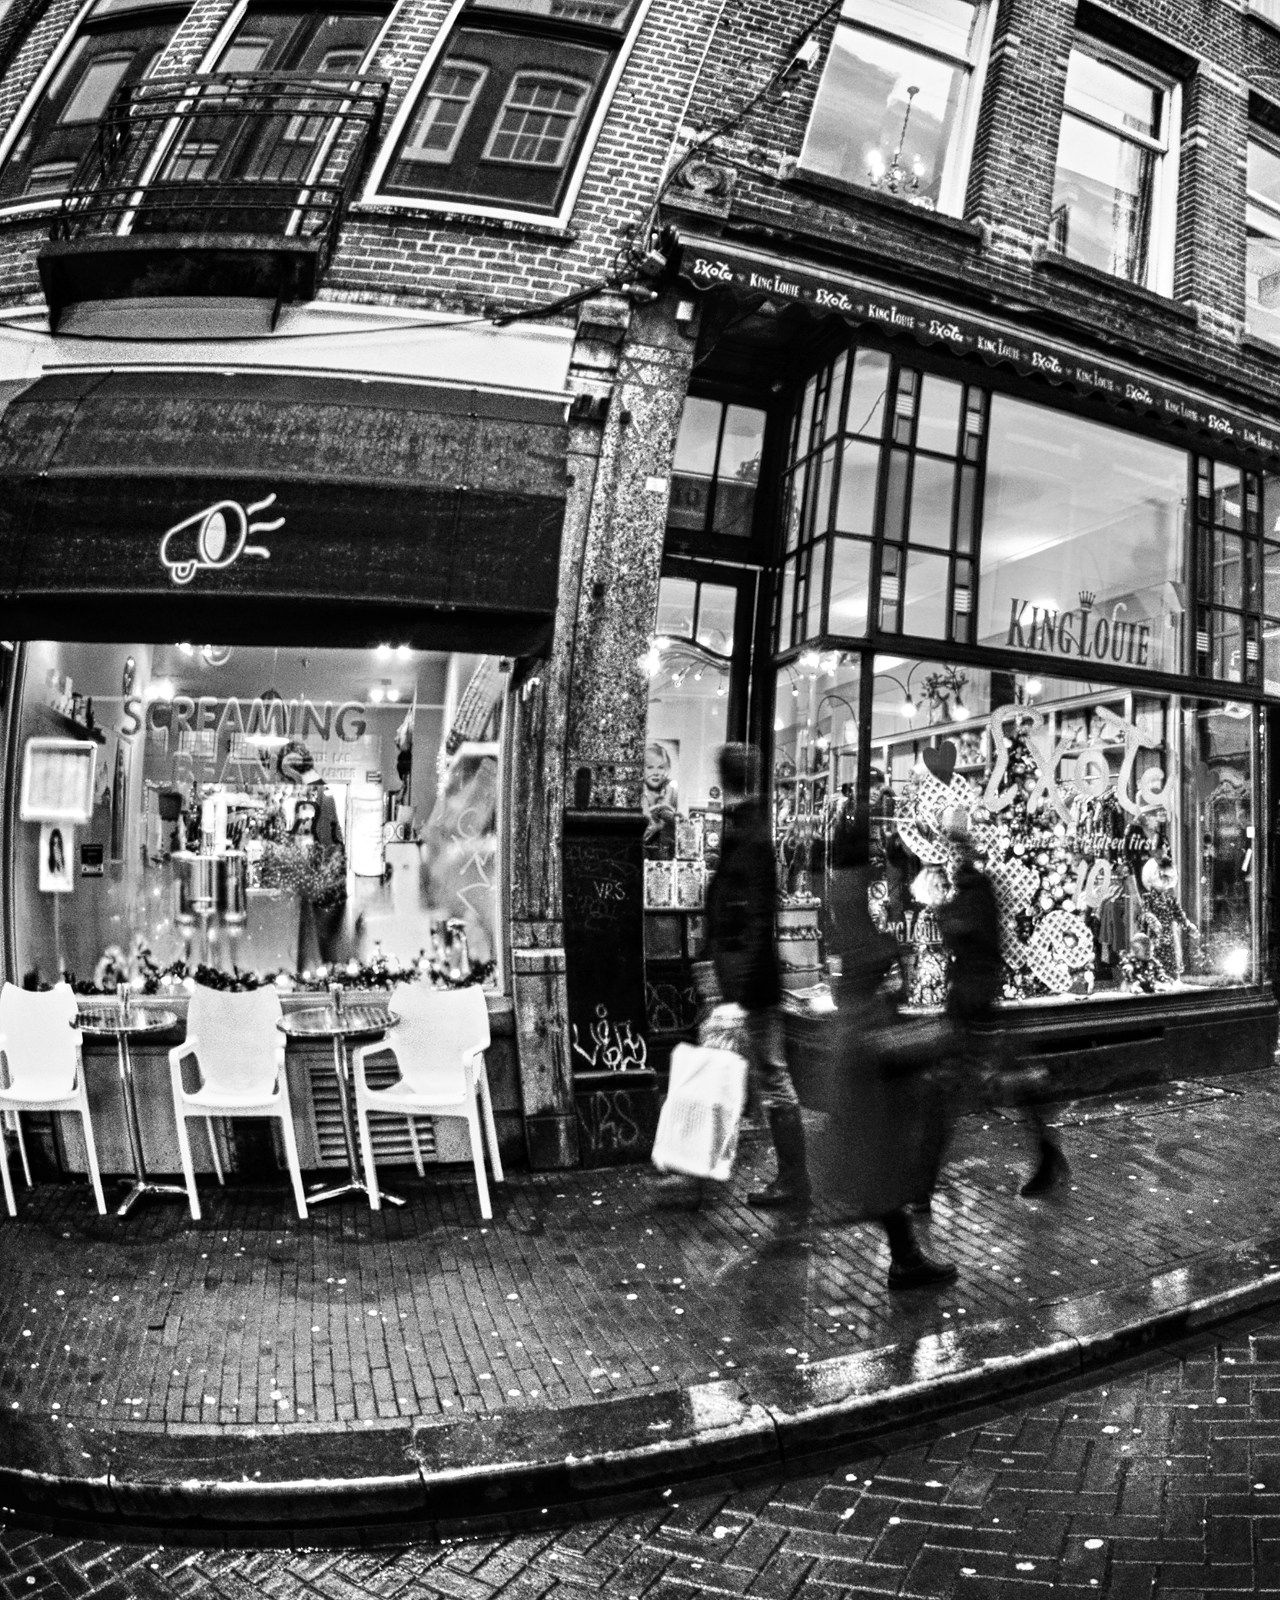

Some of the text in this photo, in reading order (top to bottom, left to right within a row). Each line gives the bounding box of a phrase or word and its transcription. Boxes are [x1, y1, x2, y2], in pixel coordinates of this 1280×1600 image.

[774, 275, 800, 298] LOUIE
[815, 288, 852, 310] Exota
[891, 307, 915, 329] LOUIE
[929, 320, 963, 342] Exota
[1032, 352, 1062, 374] Exota
[1005, 598, 1150, 666] KING LOUIE
[121, 696, 367, 742] SCREAMING
[984, 703, 1177, 828] Exota
